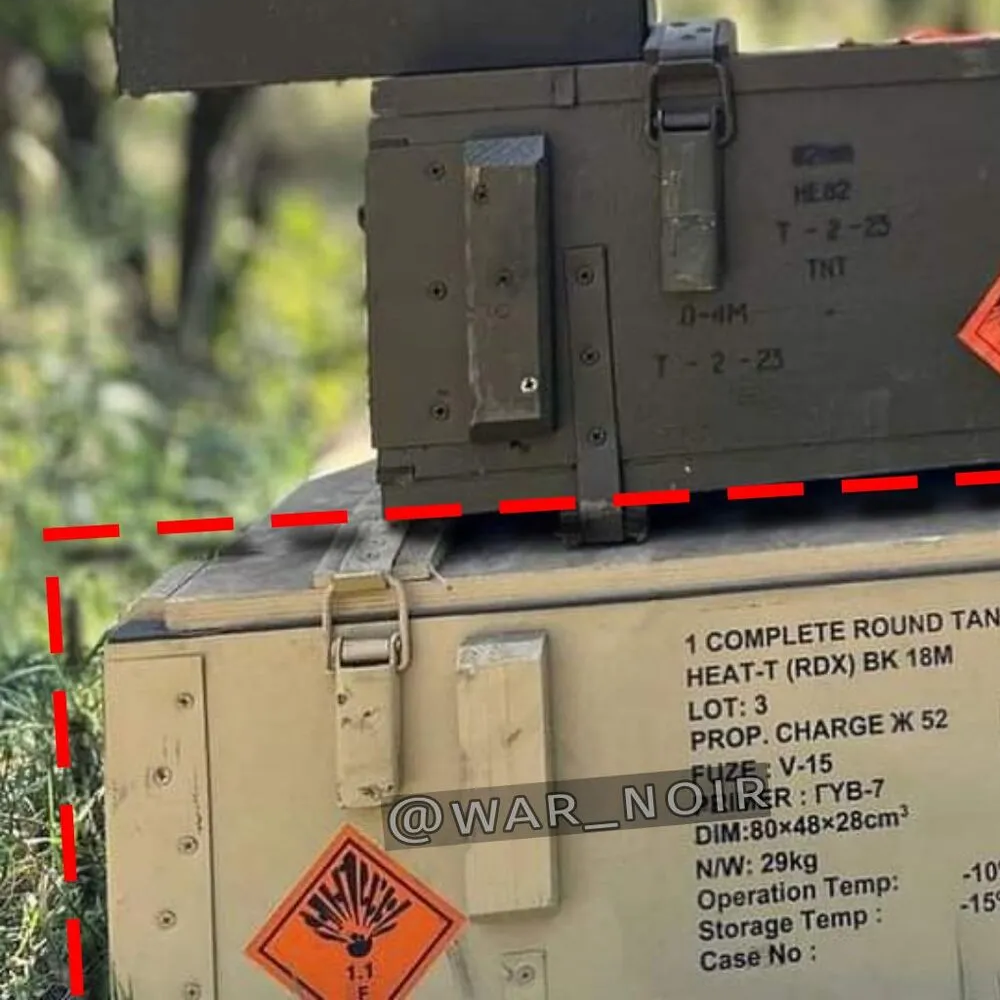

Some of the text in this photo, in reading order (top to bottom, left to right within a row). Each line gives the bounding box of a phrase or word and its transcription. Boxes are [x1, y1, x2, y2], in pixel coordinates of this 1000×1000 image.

[806, 256, 847, 281] TNT
[685, 633, 696, 654] 1
[706, 620, 845, 652] COMPLETE
[853, 613, 943, 640] ROUND
[687, 645, 953, 687] HEAT-T (RDX) BK 18M
[688, 697, 746, 721] LOT:
[754, 695, 768, 715] 3
[691, 725, 769, 750] PROP.
[775, 713, 885, 743] CHARGE
[921, 708, 948, 730] 52
[779, 753, 833, 776] V-15
[696, 855, 752, 880] N/W:
[761, 851, 818, 874] 29kg
[697, 882, 816, 912] Operation
[823, 875, 899, 897] Temp:
[699, 916, 794, 941] Storage
[347, 961, 373, 981] 1.1
[699, 950, 761, 972] Case
